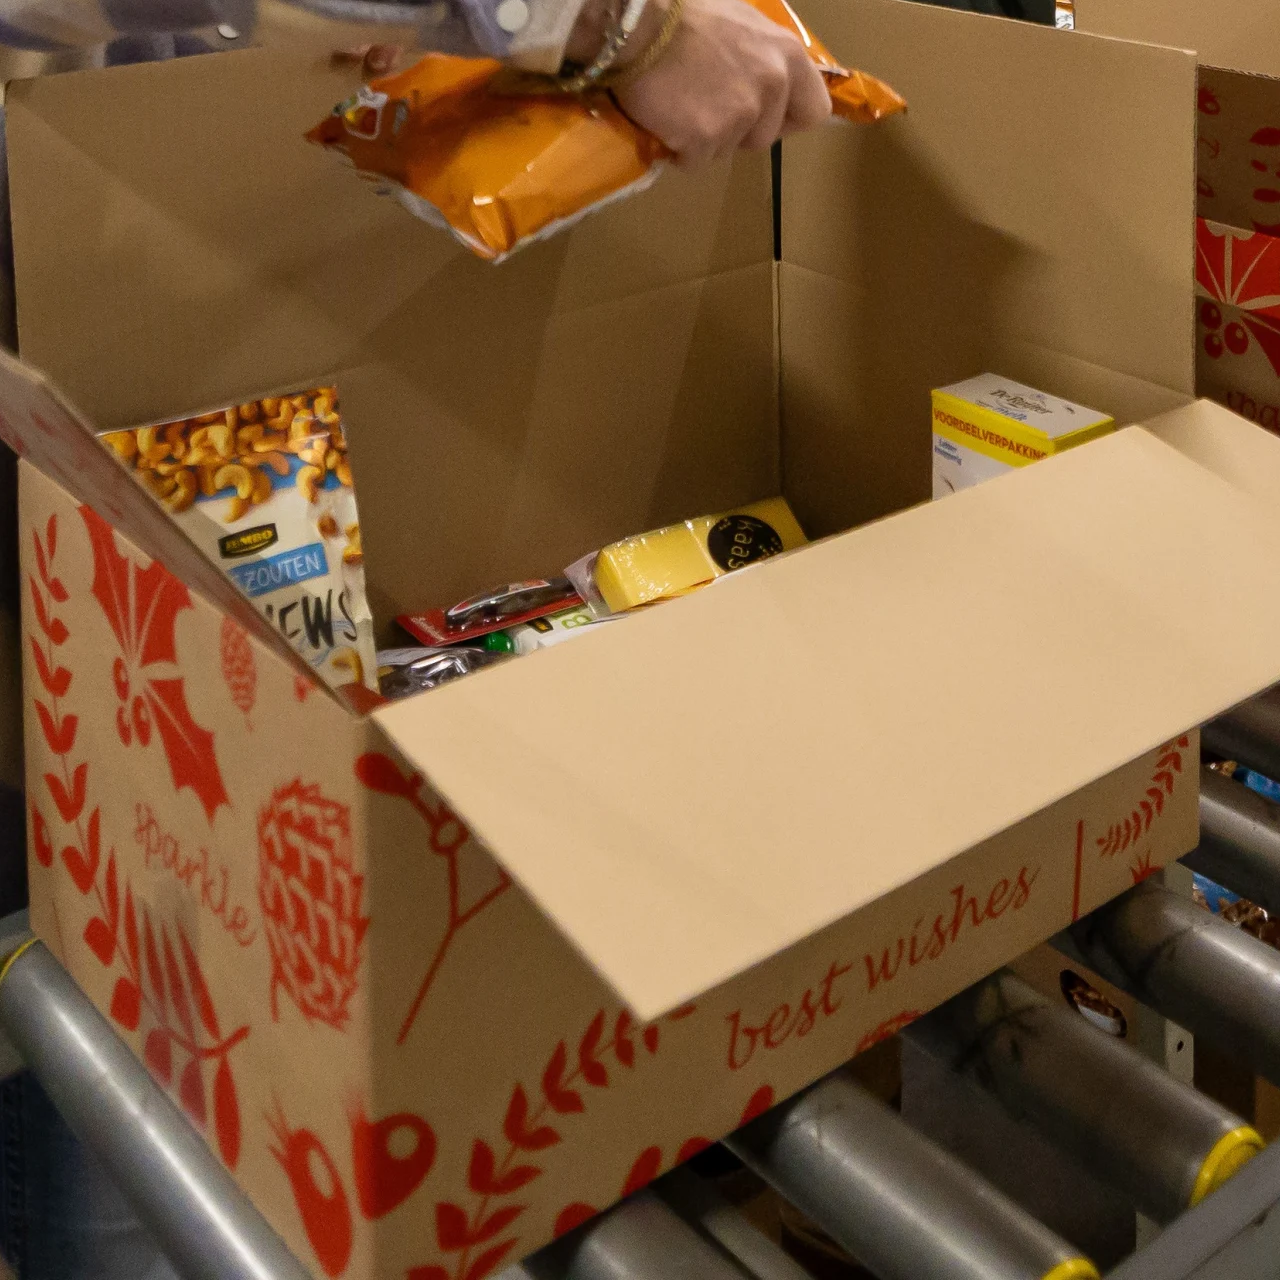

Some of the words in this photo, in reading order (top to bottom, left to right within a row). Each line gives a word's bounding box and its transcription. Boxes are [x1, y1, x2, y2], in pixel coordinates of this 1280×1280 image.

[933, 407, 1048, 461] VOORDEELVERPAKKING
[226, 529, 274, 550] JUMBO
[726, 520, 763, 570] kaas
[265, 588, 358, 649] EWS
[134, 802, 258, 948] sparkle
[725, 961, 854, 1071] best
[864, 866, 1042, 994] wishes
